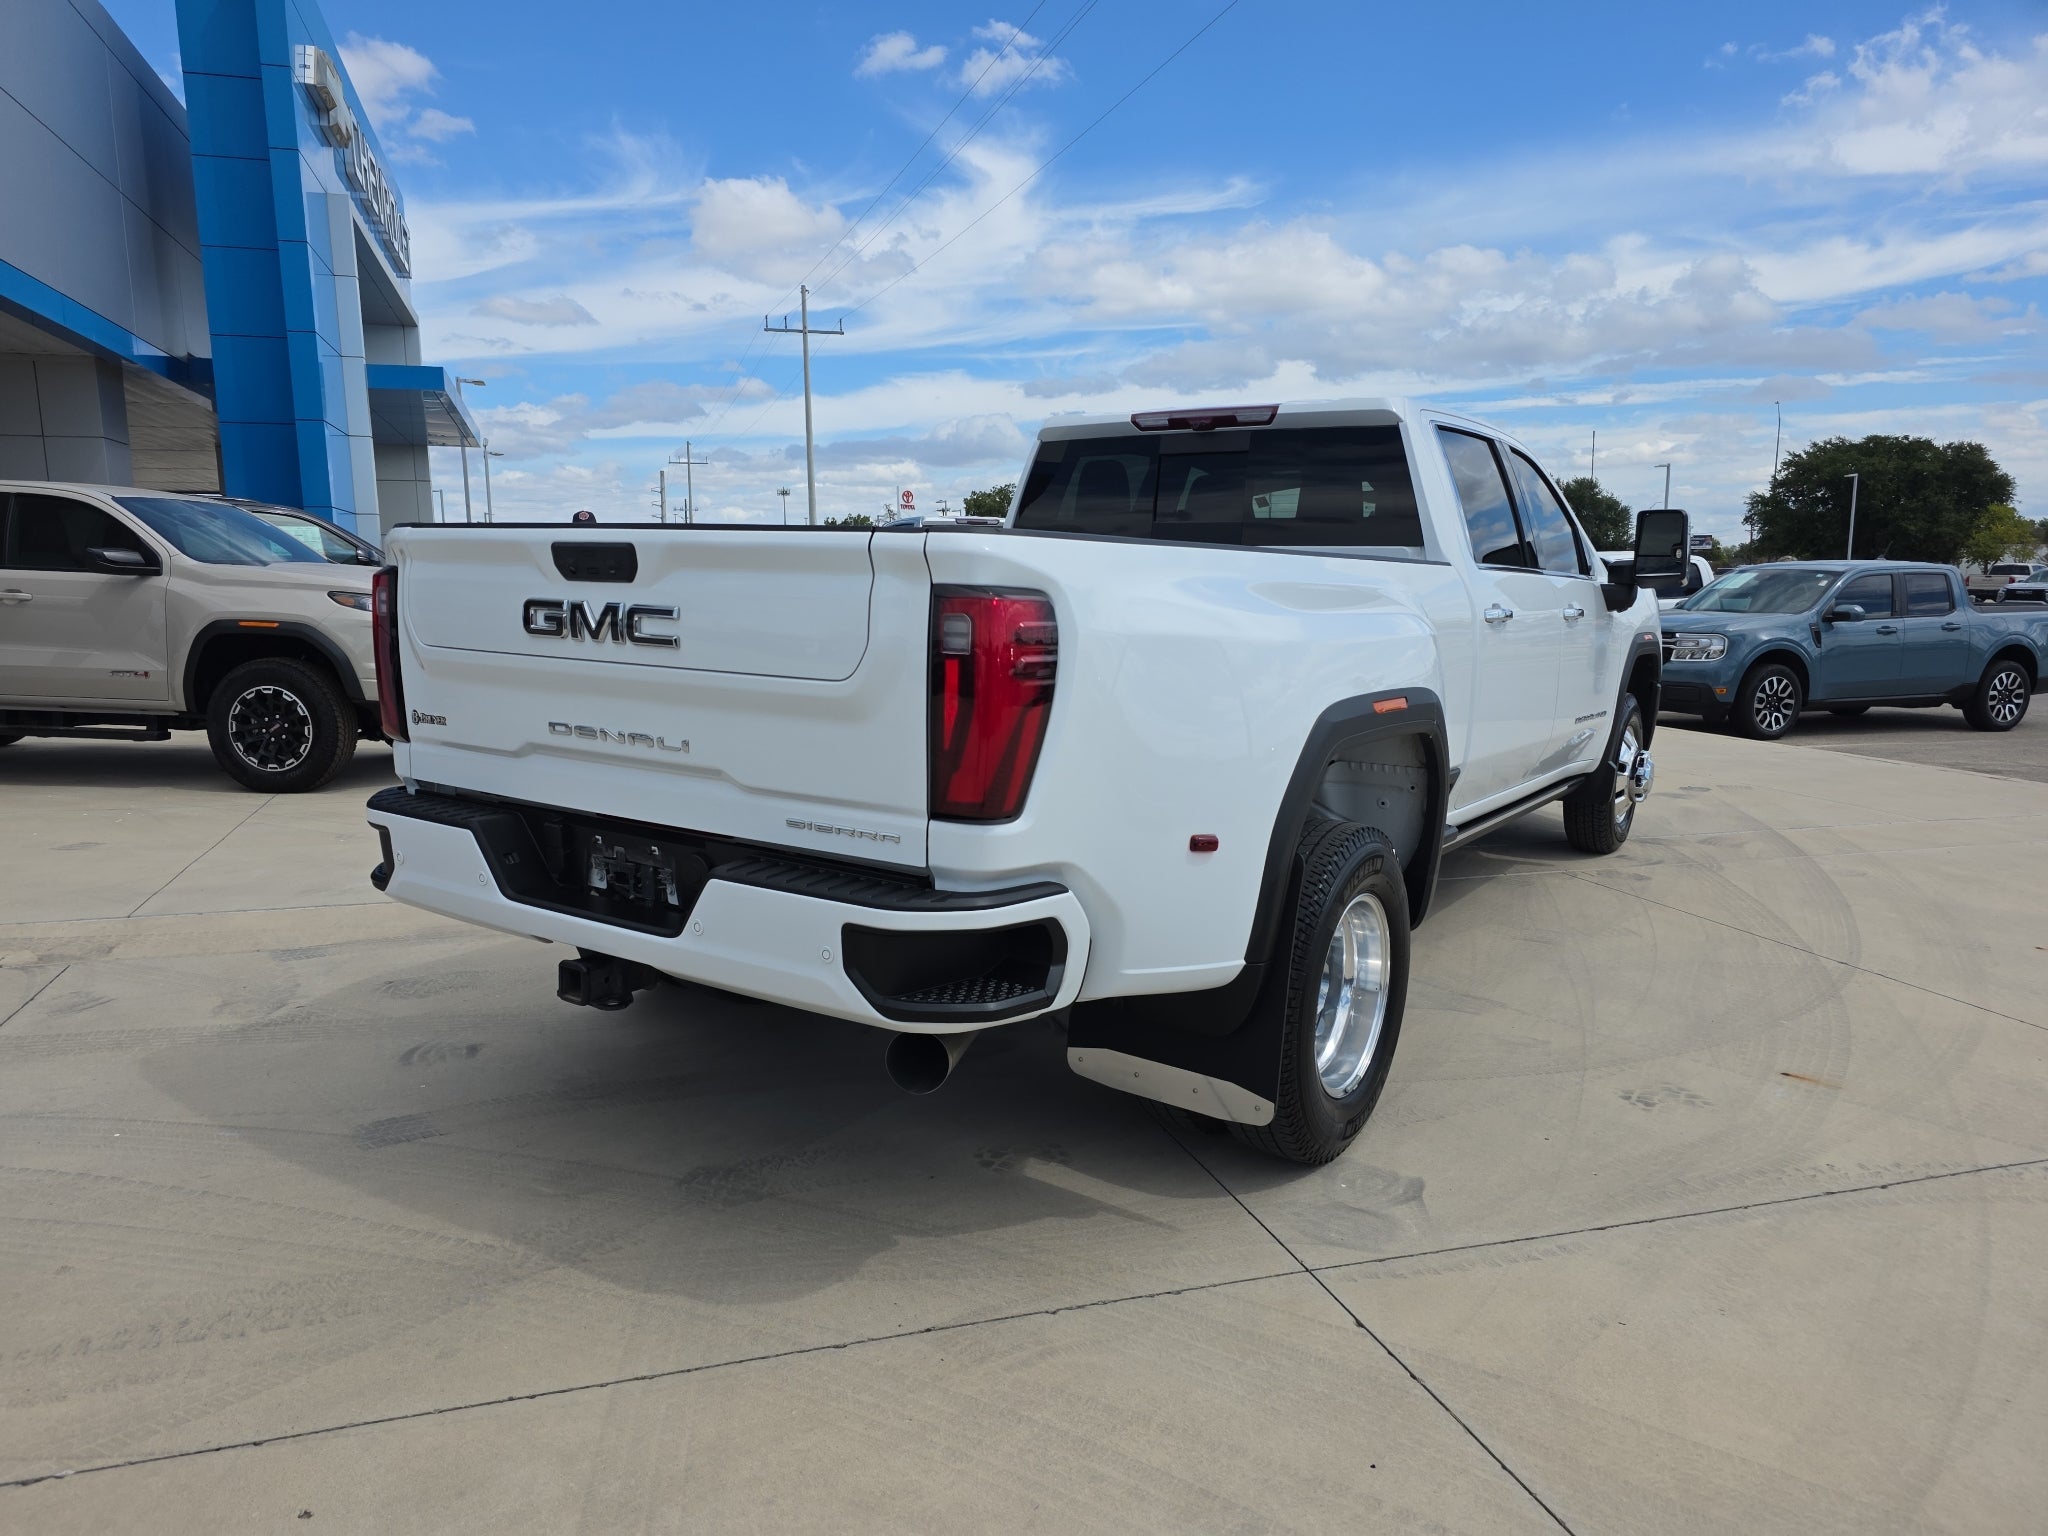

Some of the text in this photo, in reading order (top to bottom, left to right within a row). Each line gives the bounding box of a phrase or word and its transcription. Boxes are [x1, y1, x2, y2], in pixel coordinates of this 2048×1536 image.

[522, 598, 681, 650] GMC
[548, 721, 690, 754] DENALI
[785, 817, 901, 844] SIERRA
